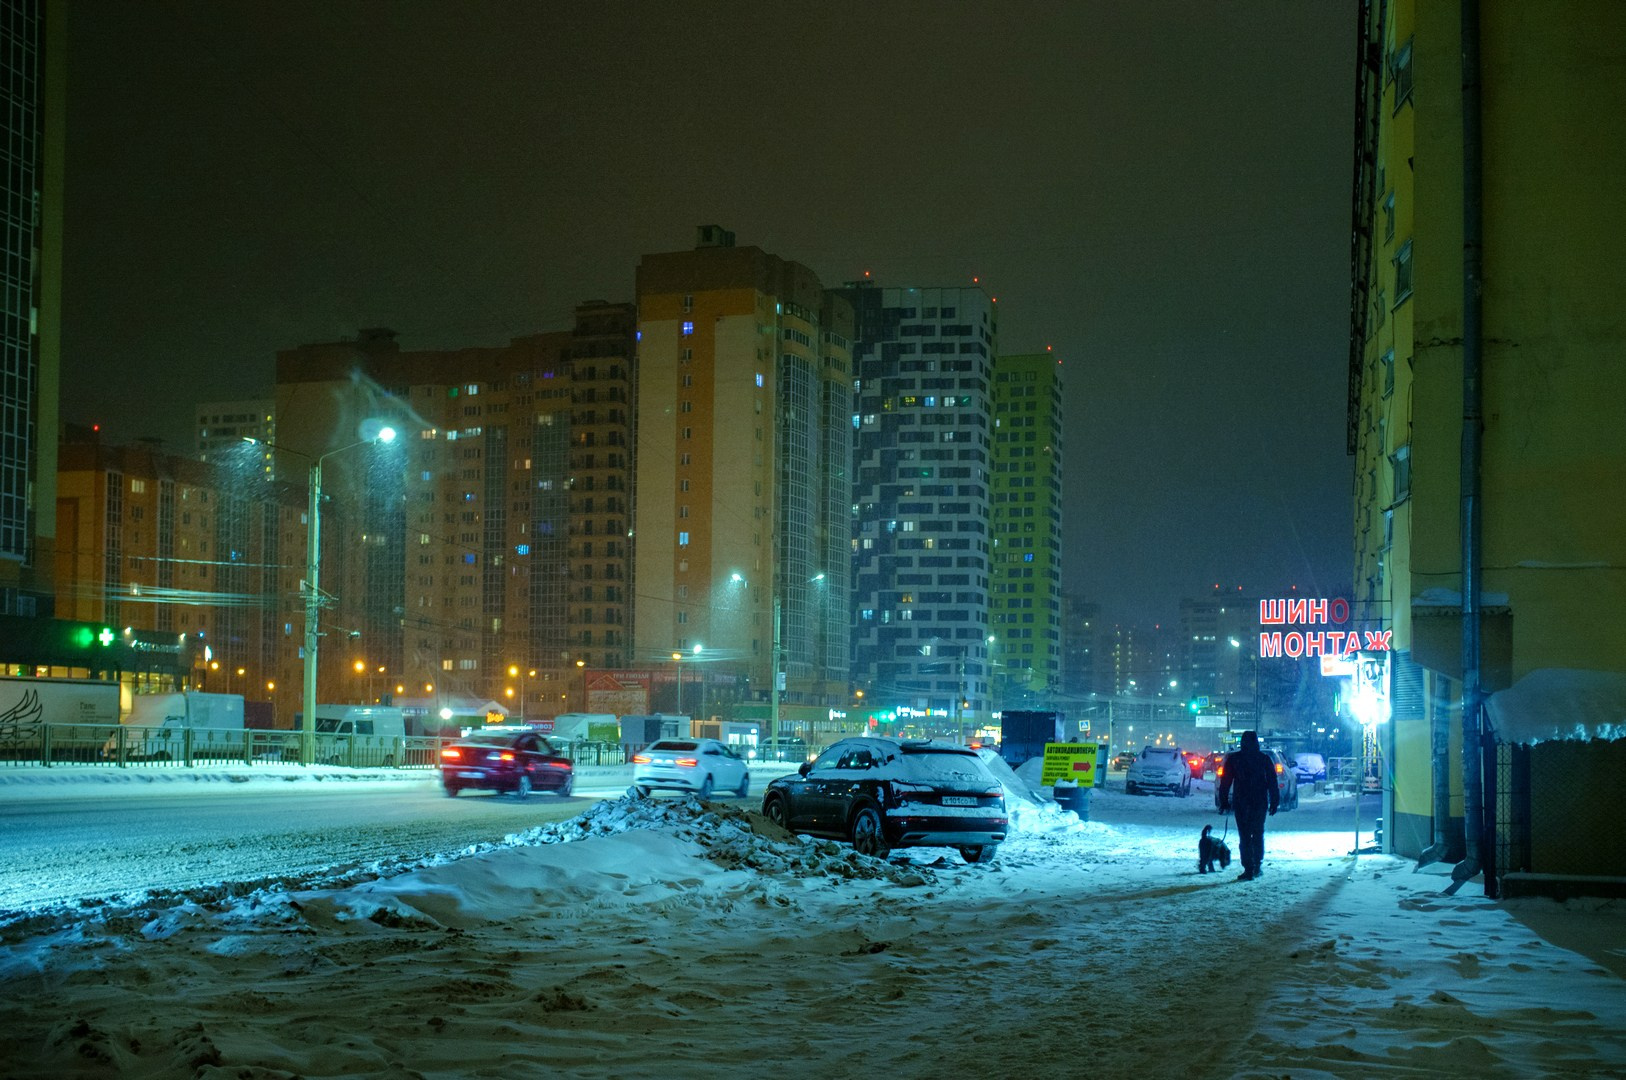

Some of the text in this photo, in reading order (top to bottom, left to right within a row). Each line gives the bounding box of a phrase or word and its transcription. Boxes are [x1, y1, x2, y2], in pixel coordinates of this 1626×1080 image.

[1260, 597, 1349, 624] ШИНО
[1260, 631, 1392, 657] МОНТАЖ
[1046, 746, 1096, 755] АВТОКОНДИЦИОНЕРЫ
